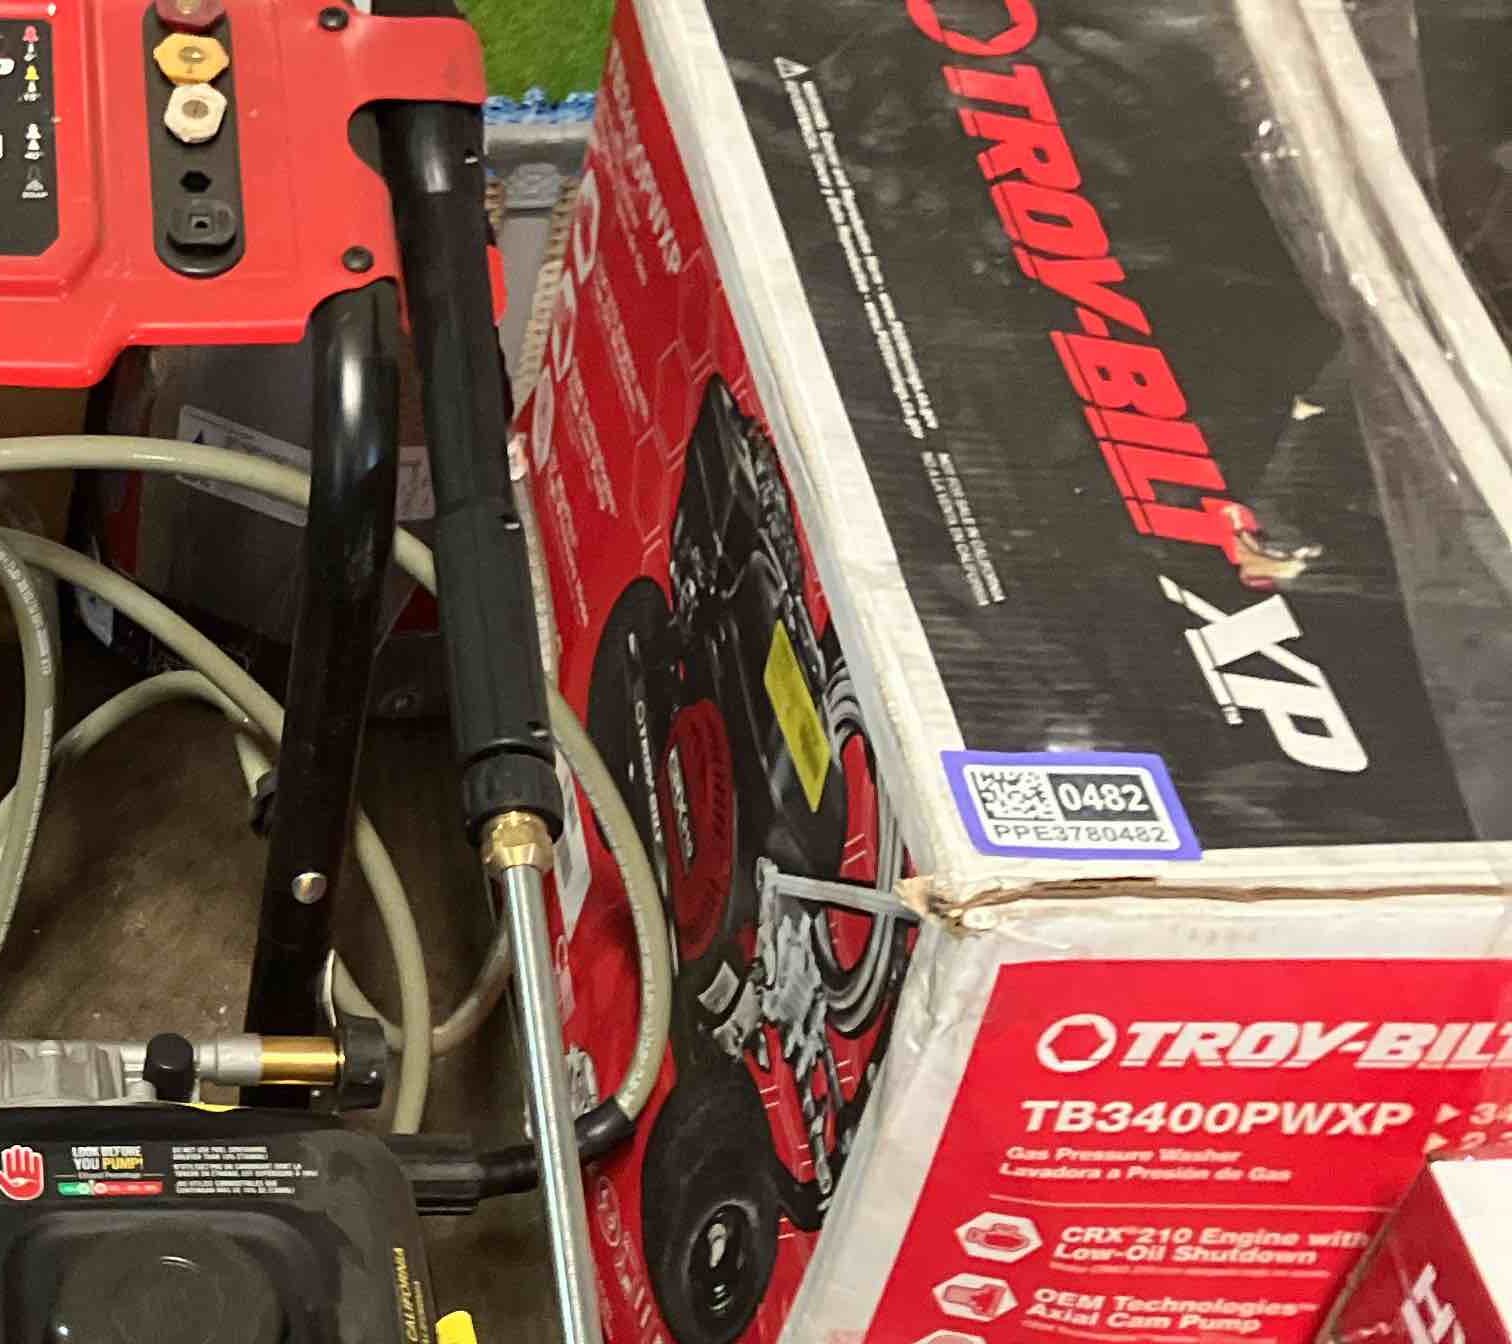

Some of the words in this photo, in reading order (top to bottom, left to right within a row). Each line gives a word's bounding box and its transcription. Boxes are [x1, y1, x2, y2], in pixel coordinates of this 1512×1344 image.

[943, 64, 1259, 568] TROY-BILT
[1158, 574, 1368, 774] XP
[1058, 782, 1150, 813] 0482
[993, 823, 1170, 844] PPE3780482
[1021, 1099, 1414, 1137] TB3400PWXP
[73, 1157, 100, 1170] YOU
[1006, 1146, 1050, 1161] Gas
[1054, 1147, 1154, 1163] Pressure
[1159, 1148, 1242, 1164] Washer
[999, 1163, 1101, 1180] Lavadora
[1108, 1169, 1122, 1180] a
[1218, 1167, 1243, 1182] de
[1248, 1168, 1293, 1183] Gas
[1139, 1227, 1193, 1245] 210
[1198, 1227, 1304, 1247] Engine
[1308, 1232, 1371, 1248] with
[1052, 1244, 1167, 1263] Low-Oil
[1171, 1245, 1318, 1264] Shutdown
[392, 1248, 418, 1340] CALIFORNIA
[1032, 1287, 1105, 1310] OEM
[1025, 1304, 1100, 1326] Axial
[1109, 1312, 1174, 1330] Cam
[1178, 1314, 1262, 1334] Pump
